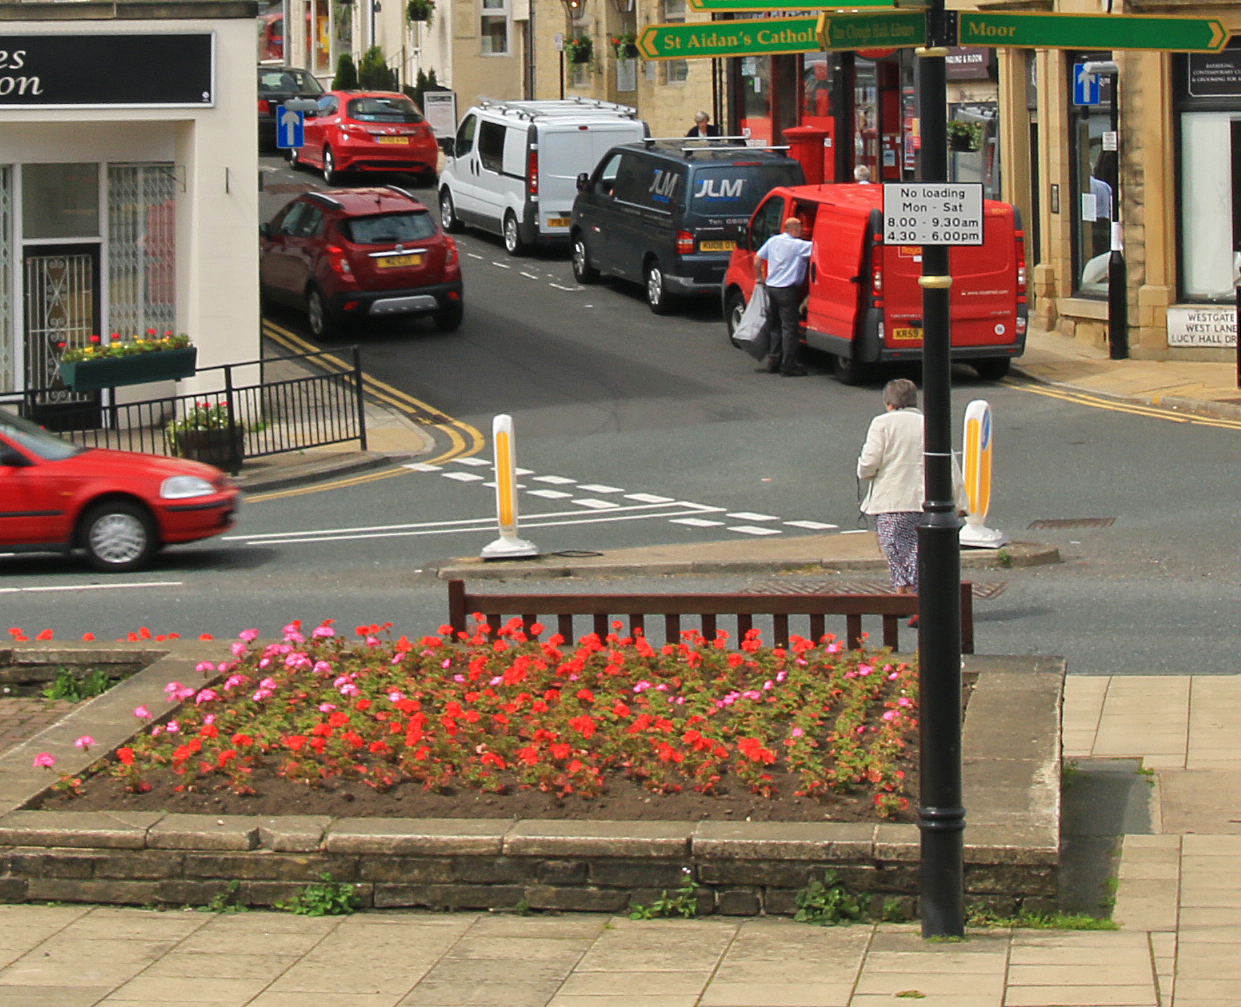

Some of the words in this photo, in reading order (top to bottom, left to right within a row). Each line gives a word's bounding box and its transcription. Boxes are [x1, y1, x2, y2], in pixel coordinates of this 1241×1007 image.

[969, 21, 1016, 38] Moor
[664, 34, 682, 50] St
[687, 30, 752, 48] Aidan's
[648, 169, 680, 198] JLM
[694, 179, 744, 198] JLM
[900, 188, 917, 198] No
[922, 188, 965, 200] loading
[902, 203, 927, 212] Mon
[943, 203, 964, 212] Sat
[887, 218, 916, 227] 8.00
[932, 218, 978, 227] 9.30am
[887, 232, 916, 241] 4.30
[932, 232, 979, 242] 6.00pm
[1188, 313, 1235, 322] WESTGATE
[1186, 324, 1210, 332] WEST
[1214, 324, 1237, 332] LANE
[896, 330, 919, 338] KR59
[1172, 334, 1195, 343] LUCY
[1198, 335, 1221, 343] HALL
